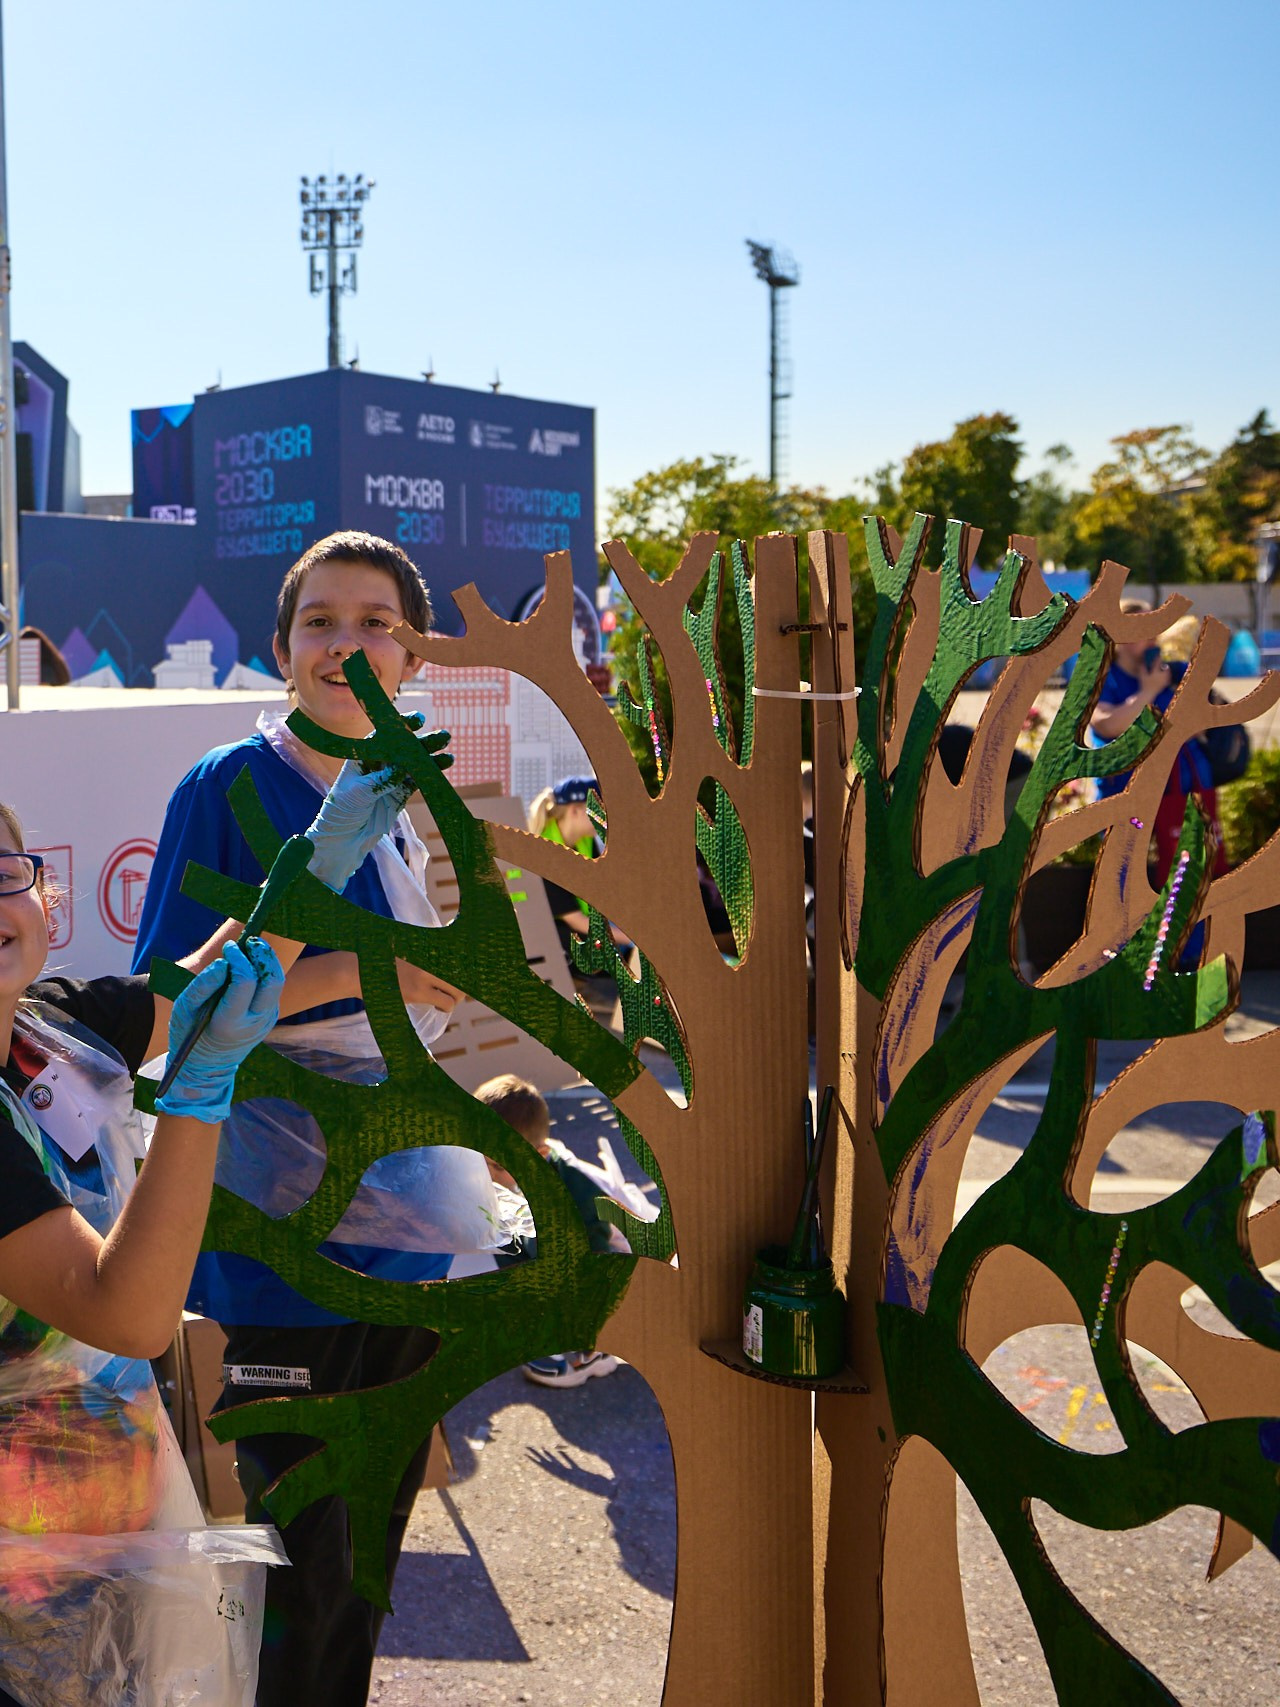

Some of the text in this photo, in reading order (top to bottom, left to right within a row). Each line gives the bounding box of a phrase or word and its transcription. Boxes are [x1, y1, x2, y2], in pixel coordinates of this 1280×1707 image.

[418, 413, 455, 432] ЛЕТО
[214, 424, 312, 469] МОСКВА
[216, 467, 274, 505] 2030
[365, 474, 444, 510] МОСКВА
[484, 484, 581, 519] ТЕРРИТОРИЯ
[216, 500, 315, 532] ТЕРРИТОРИЯ
[397, 511, 445, 545] 2030
[483, 519, 569, 550] БУДУЩЕГО
[241, 1367, 290, 1380] WARNING
